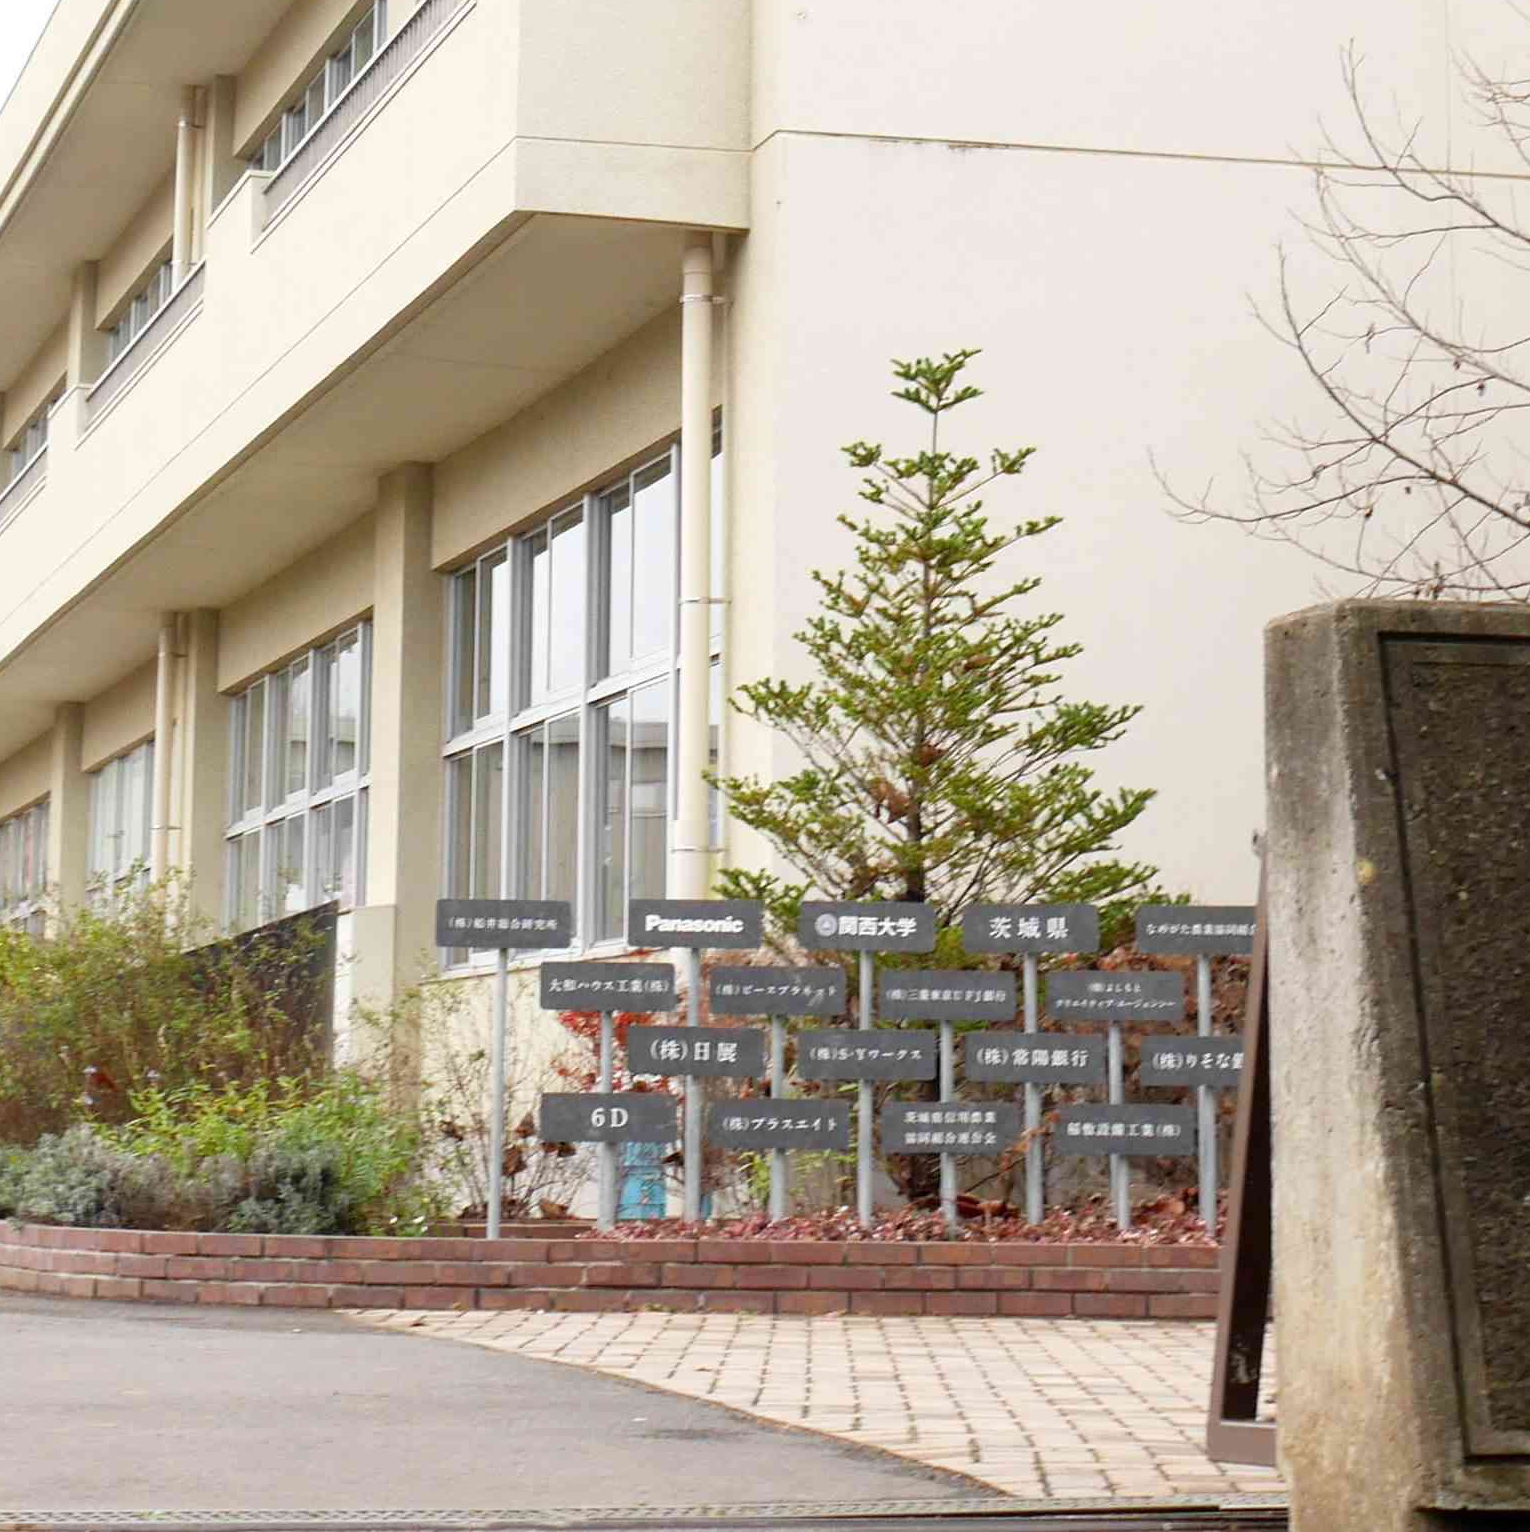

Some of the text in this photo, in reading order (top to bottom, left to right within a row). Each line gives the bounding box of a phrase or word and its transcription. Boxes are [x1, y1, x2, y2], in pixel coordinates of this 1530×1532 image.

[645, 914, 744, 933] Panasonic
[838, 915, 918, 939] 関西大学
[989, 916, 1069, 939] 茨城県
